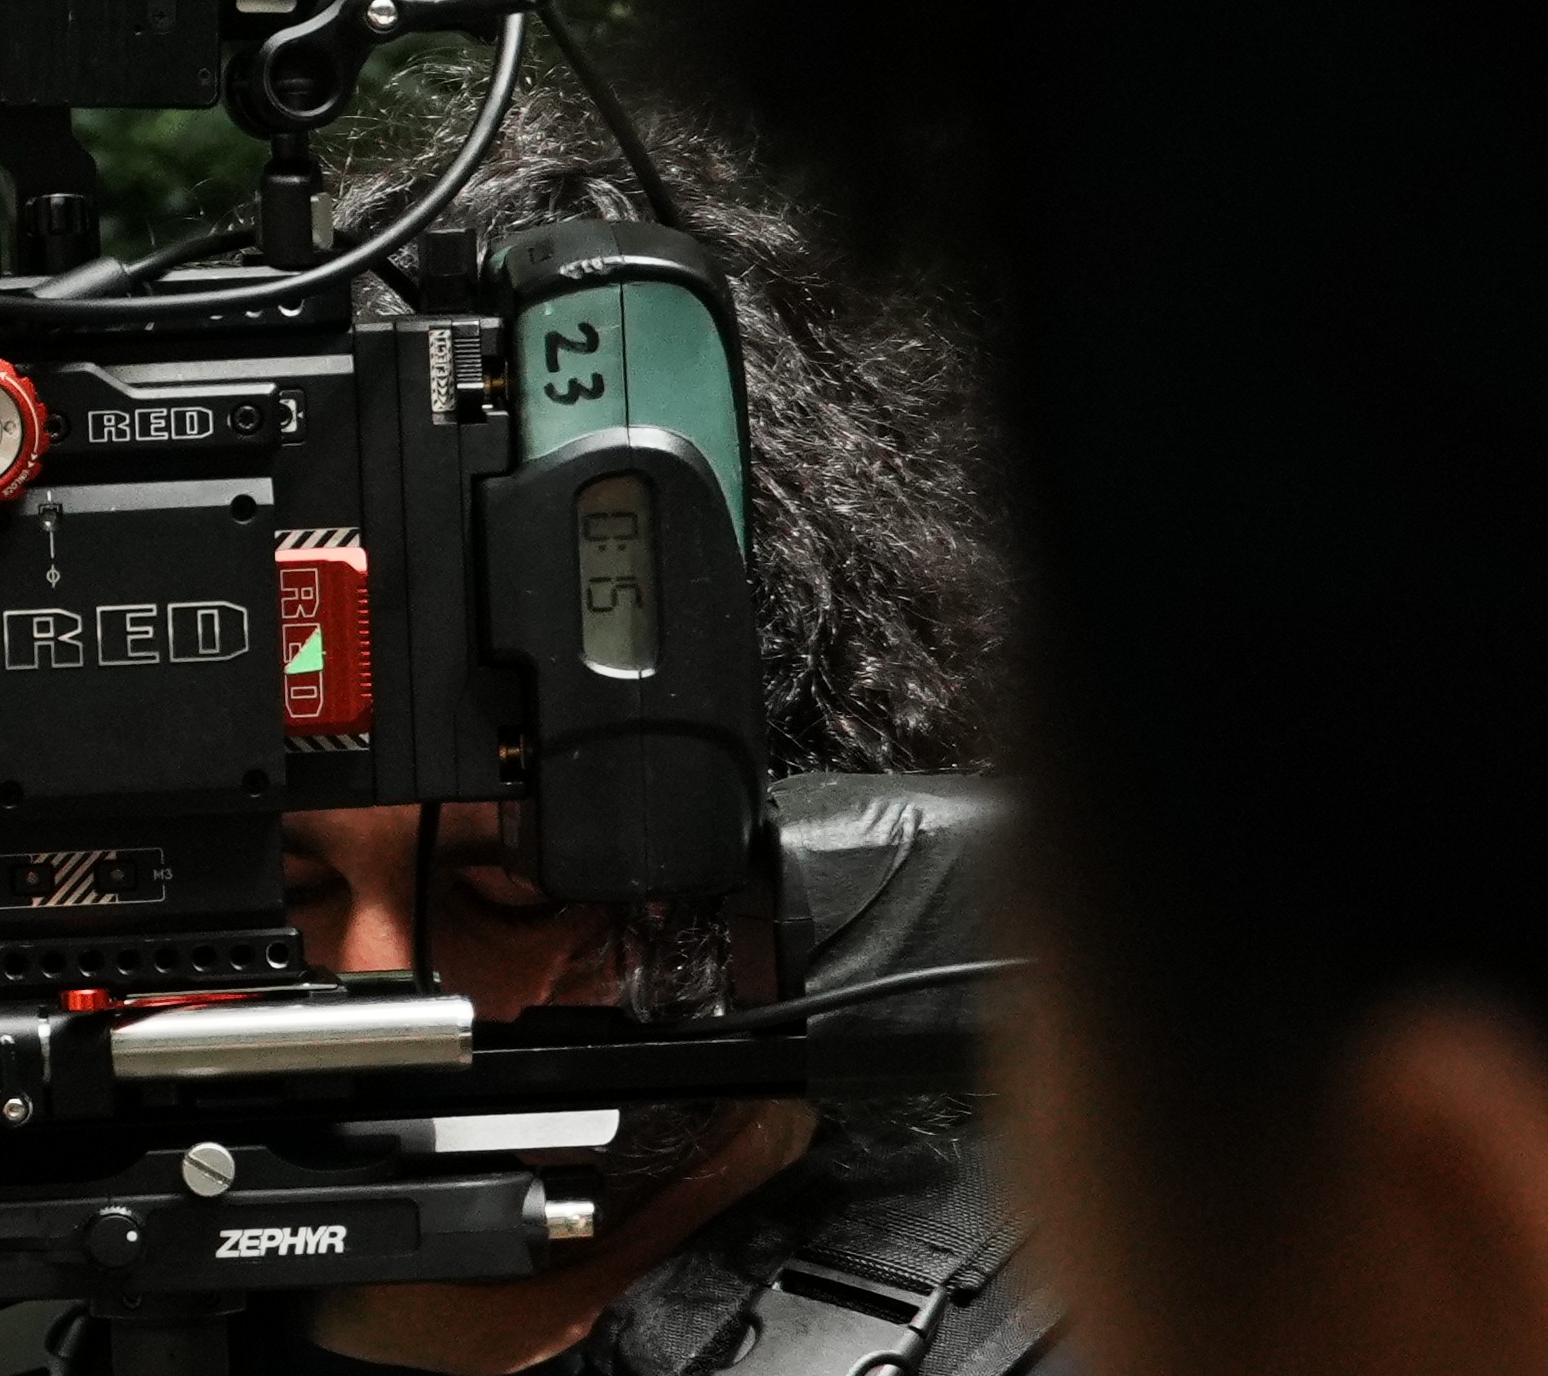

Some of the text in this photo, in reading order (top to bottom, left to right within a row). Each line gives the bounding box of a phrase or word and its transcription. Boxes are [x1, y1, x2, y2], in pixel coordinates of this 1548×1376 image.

[543, 321, 605, 406] 23
[87, 406, 214, 443] RED
[2, 600, 249, 671] RED
[153, 869, 174, 881] M3
[215, 1224, 348, 1259] ZEPHYR
